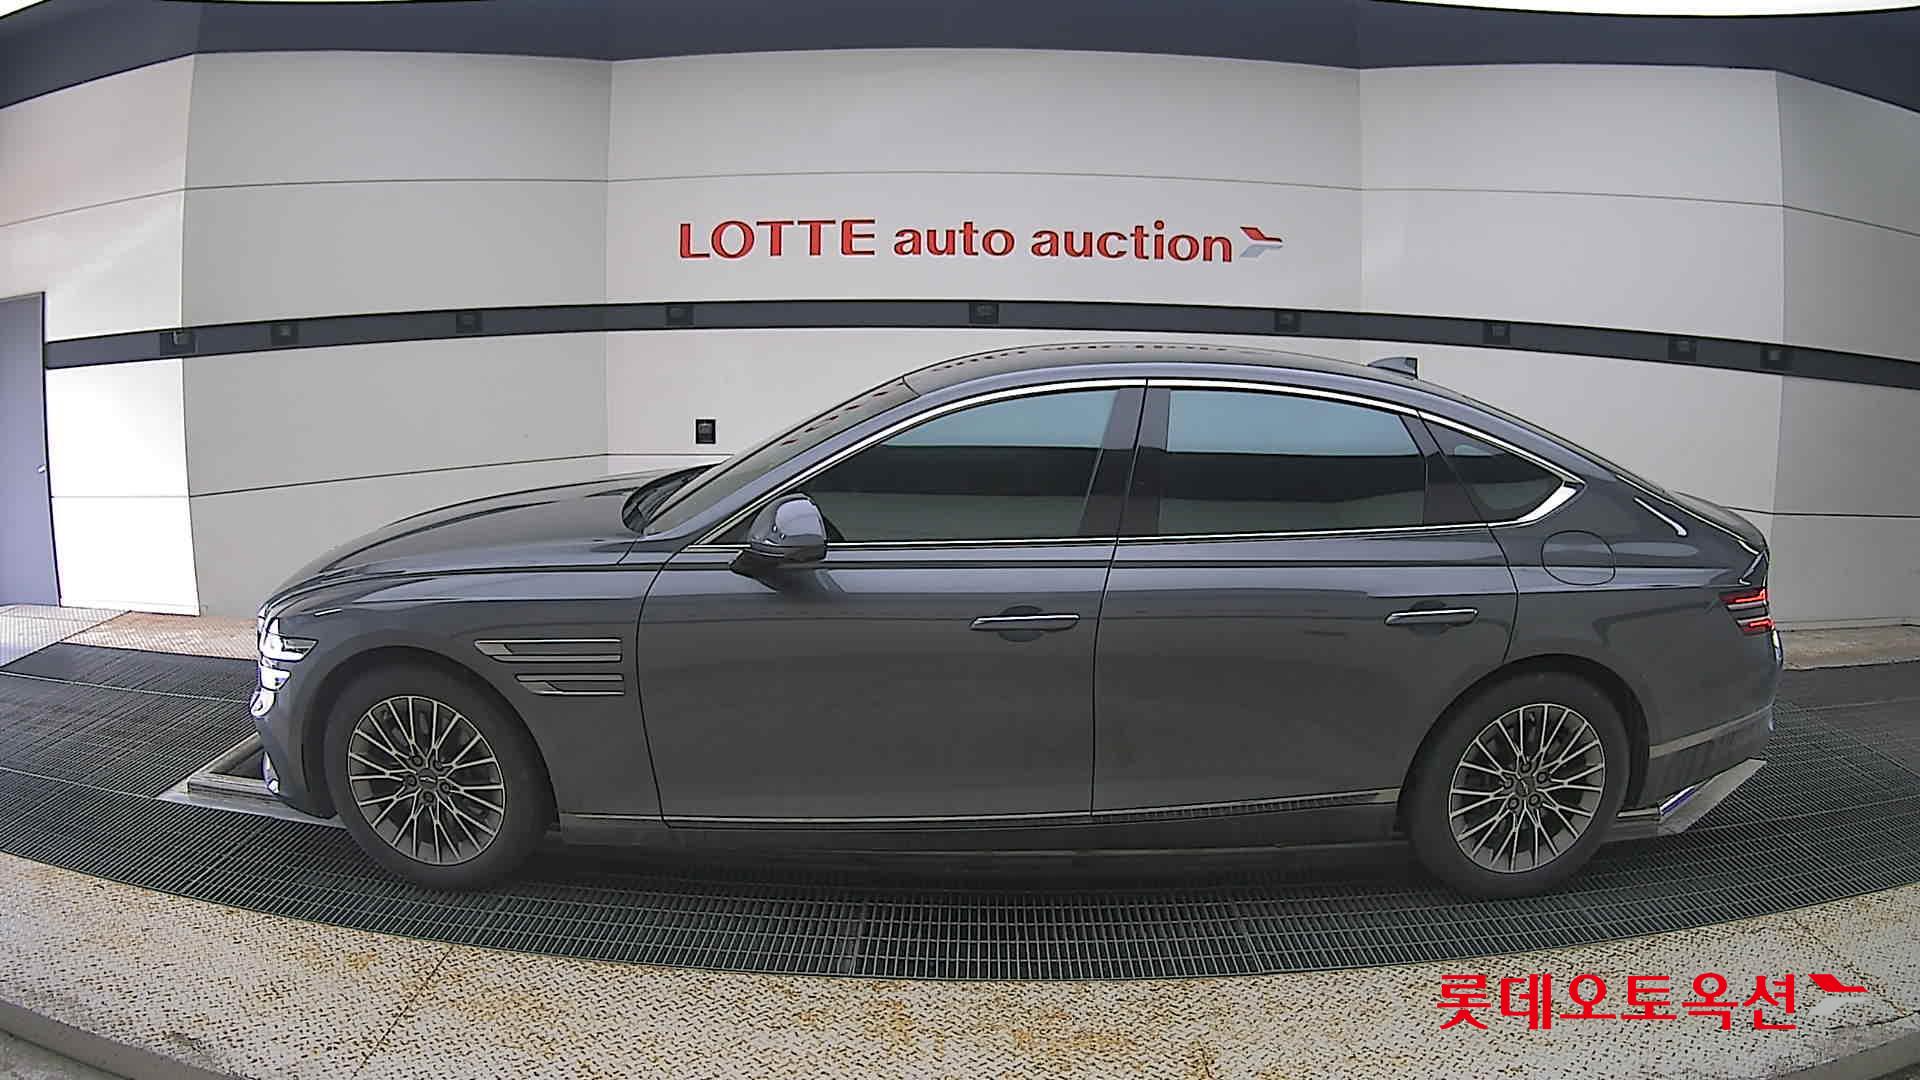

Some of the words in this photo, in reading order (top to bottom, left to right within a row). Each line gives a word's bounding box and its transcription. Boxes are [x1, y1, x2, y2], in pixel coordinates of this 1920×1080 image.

[679, 219, 876, 259] LOTTE
[893, 221, 1015, 256] auto
[1031, 220, 1232, 262] auction
